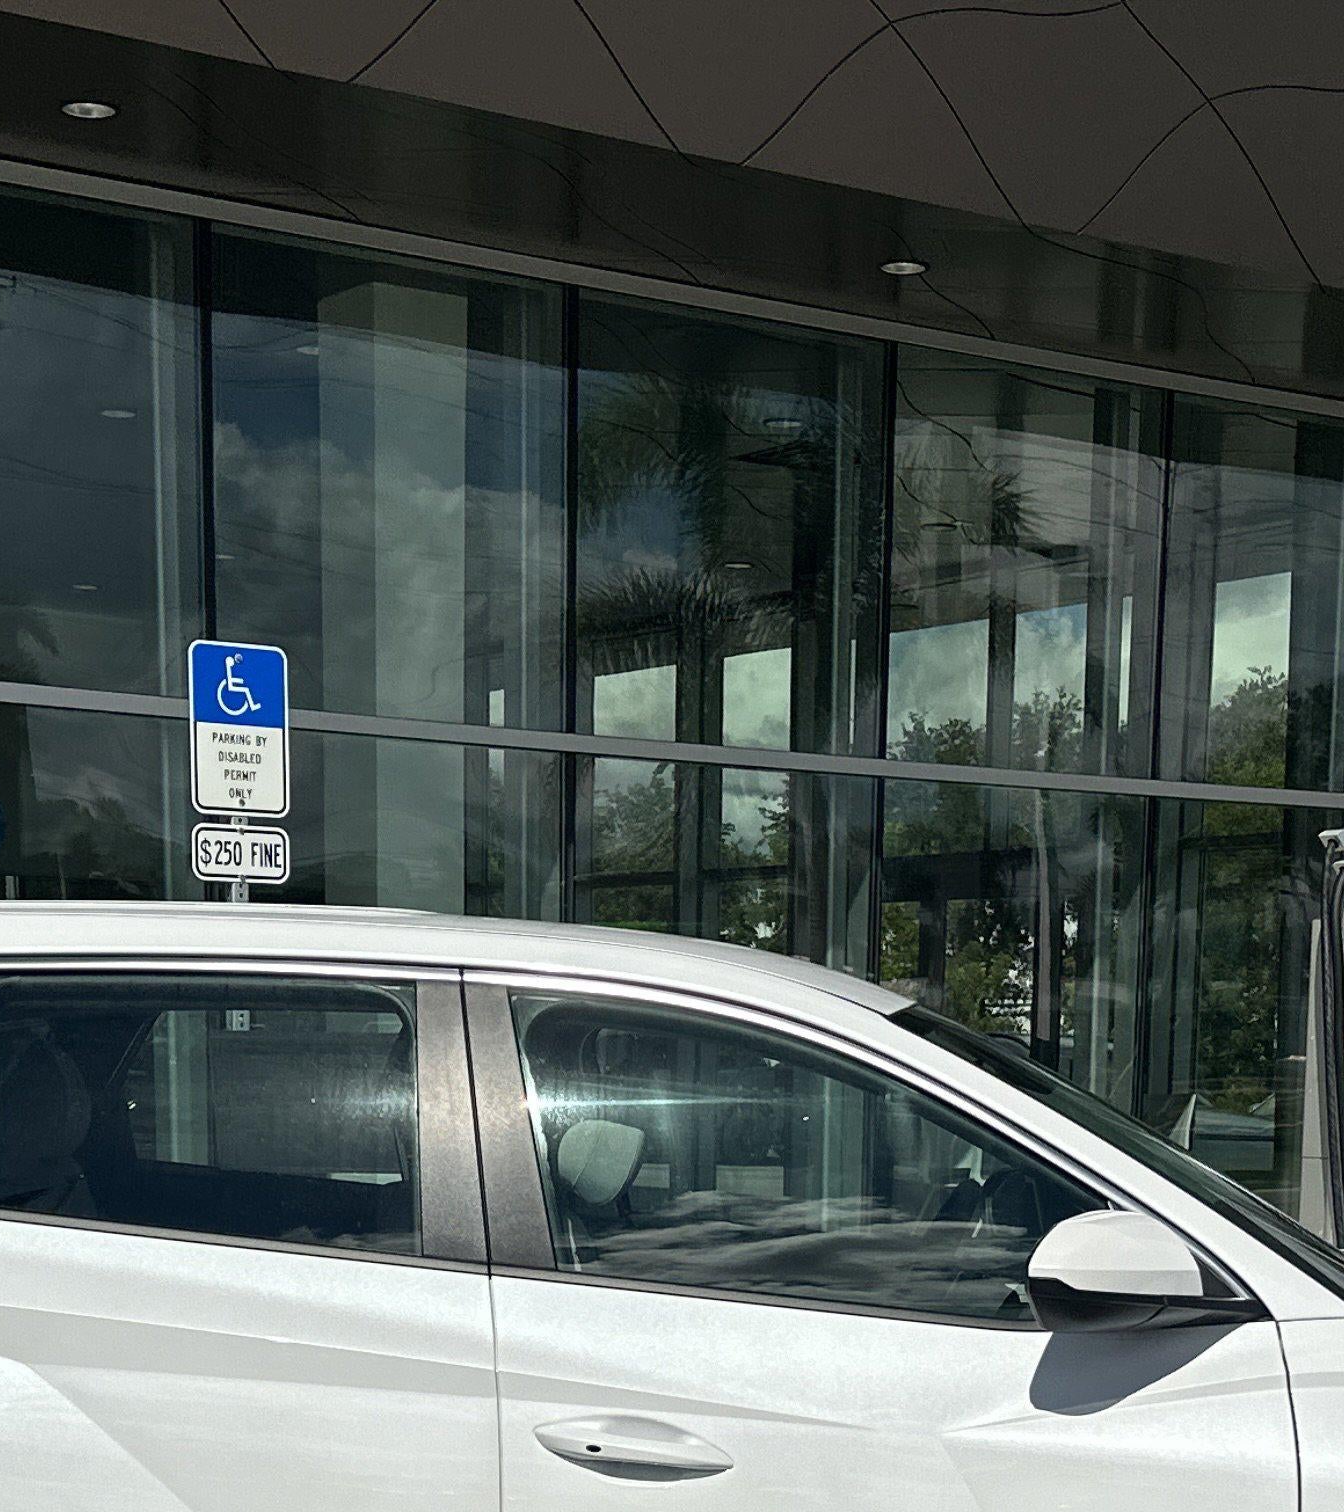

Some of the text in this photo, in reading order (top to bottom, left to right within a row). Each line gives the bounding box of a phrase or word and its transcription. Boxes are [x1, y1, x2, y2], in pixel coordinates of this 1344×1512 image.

[212, 732, 268, 747] PARKING BY
[218, 751, 262, 764] DISABLED
[224, 768, 256, 782] PERMIT
[228, 787, 253, 799] ONLY
[200, 837, 283, 869] $250 FINE
